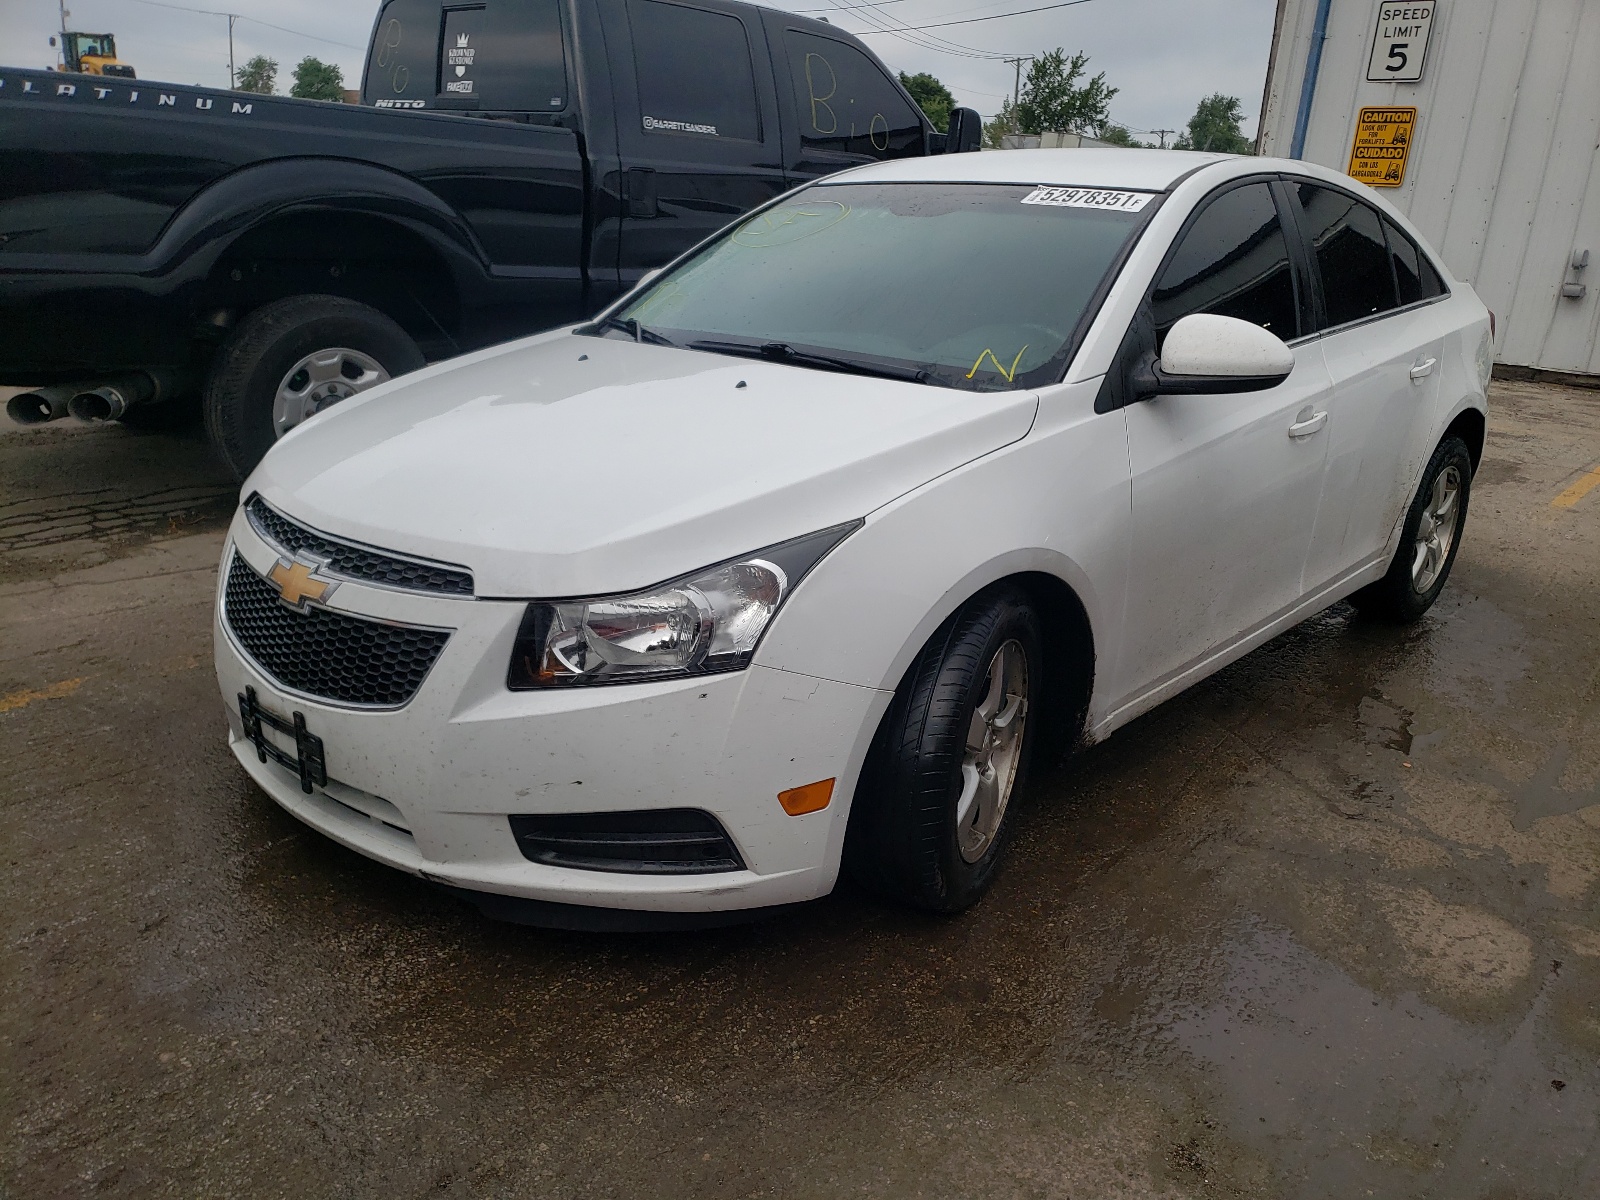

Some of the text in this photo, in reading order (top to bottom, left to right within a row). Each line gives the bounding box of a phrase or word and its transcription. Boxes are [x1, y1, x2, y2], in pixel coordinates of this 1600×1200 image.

[1382, 8, 1430, 21] SPEED
[1384, 26, 1422, 38] LIMIT
[1385, 43, 1409, 72] 5
[0, 78, 253, 115] LATINUM
[375, 99, 426, 108] NITTO
[1363, 112, 1412, 122] CAUTION
[1356, 147, 1403, 158] CUIDADO
[1351, 170, 1383, 178] CARGADORAS
[965, 344, 1030, 383] N
